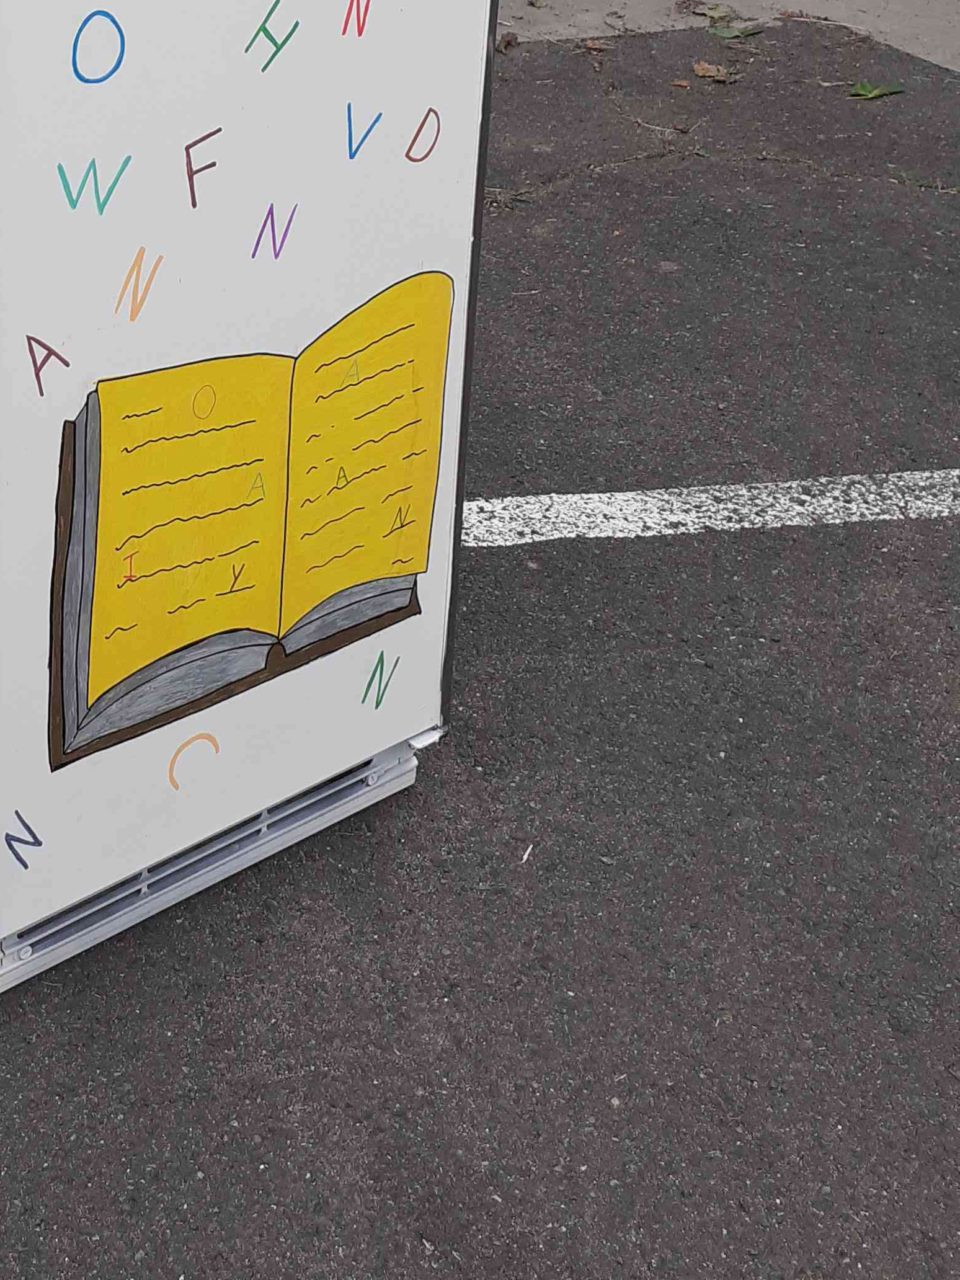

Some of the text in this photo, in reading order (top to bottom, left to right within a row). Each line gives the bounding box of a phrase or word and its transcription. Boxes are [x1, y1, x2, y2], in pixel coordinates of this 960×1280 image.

[404, 106, 441, 162] D
[56, 154, 132, 216] W
[184, 126, 223, 209] F
[251, 203, 299, 260] N
[114, 246, 164, 322] N
[25, 334, 70, 397] A
[361, 651, 400, 710] N
